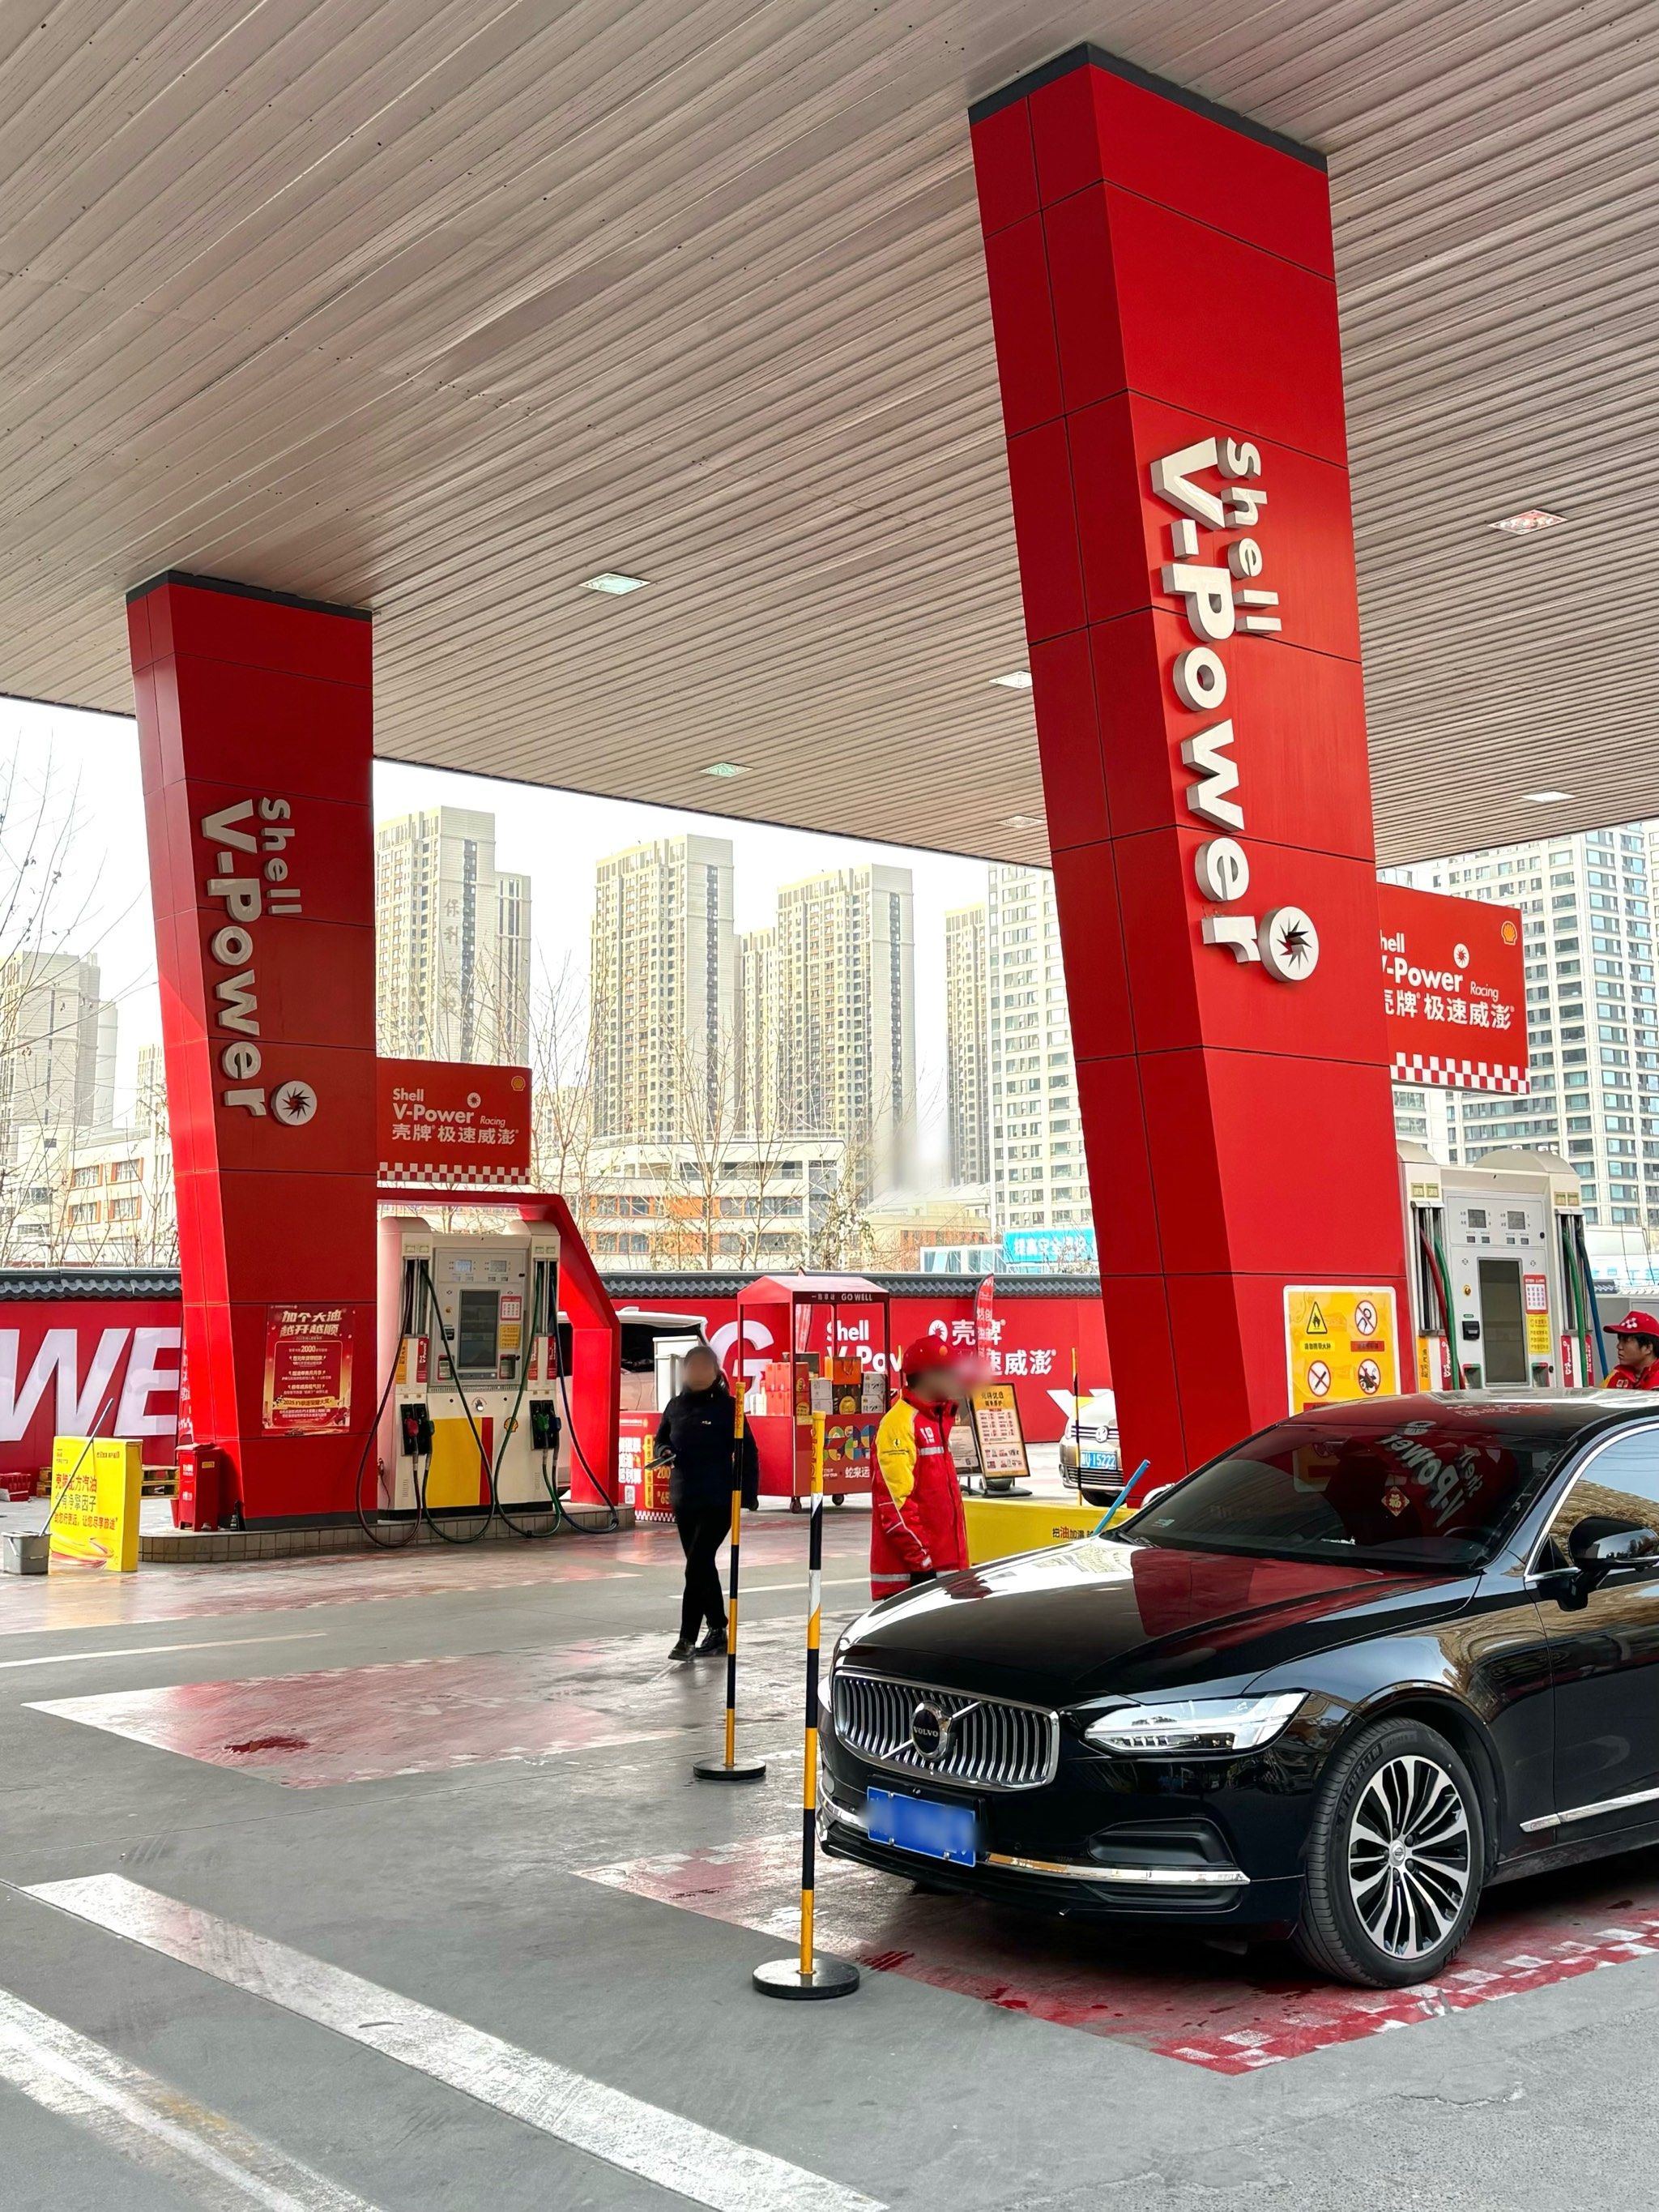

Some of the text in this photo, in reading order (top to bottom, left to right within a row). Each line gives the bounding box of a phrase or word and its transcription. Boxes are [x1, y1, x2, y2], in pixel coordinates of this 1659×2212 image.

[1218, 436, 1282, 632] Shell
[1150, 436, 1261, 963] V-Power
[258, 796, 302, 914] Shell
[202, 799, 267, 1117] V-Power
[1469, 980, 1499, 1002] Racing
[1423, 993, 1512, 1031] 极速威澎
[393, 1088, 424, 1102] Shell
[393, 1103, 506, 1127] V-Power Racing
[392, 1124, 516, 1145] 壳牌 极速威澎
[282, 1309, 342, 1322] 加个大油
[279, 1324, 339, 1338] 越开越顺
[913, 1726, 939, 1738] VOLVO
